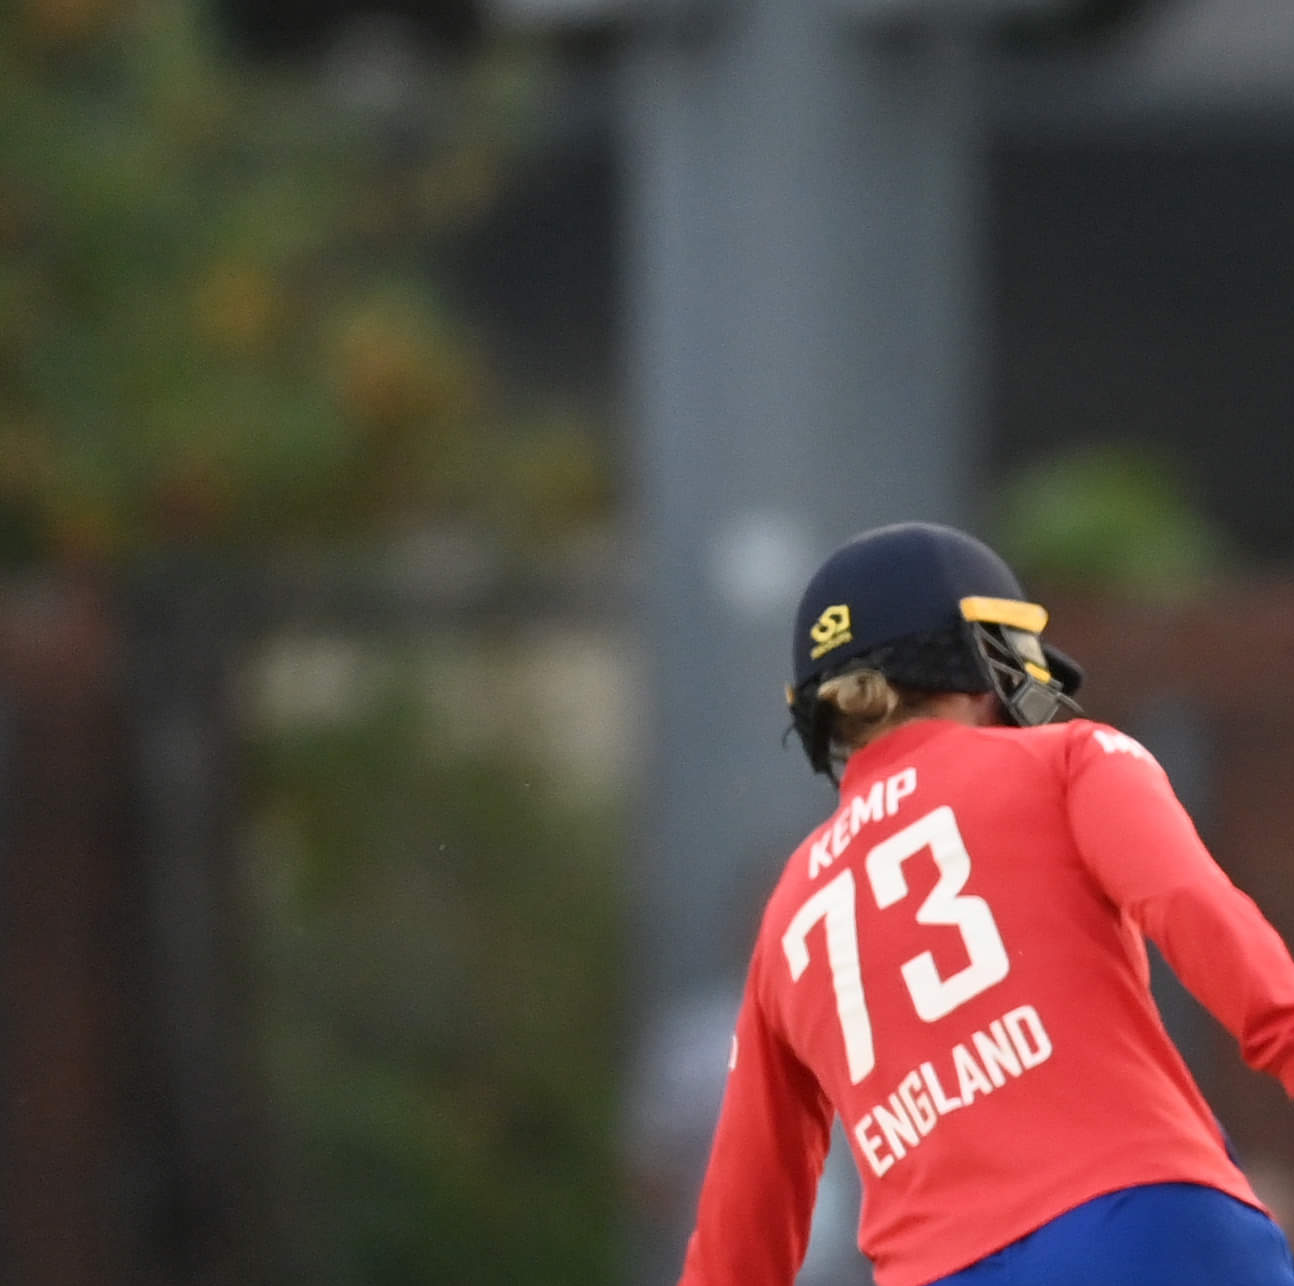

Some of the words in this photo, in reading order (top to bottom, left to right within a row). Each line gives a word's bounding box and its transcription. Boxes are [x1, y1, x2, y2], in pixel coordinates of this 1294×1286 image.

[808, 767, 917, 880] KEMP
[782, 805, 1011, 1086] 73
[854, 1004, 1054, 1178] ENGLAND
